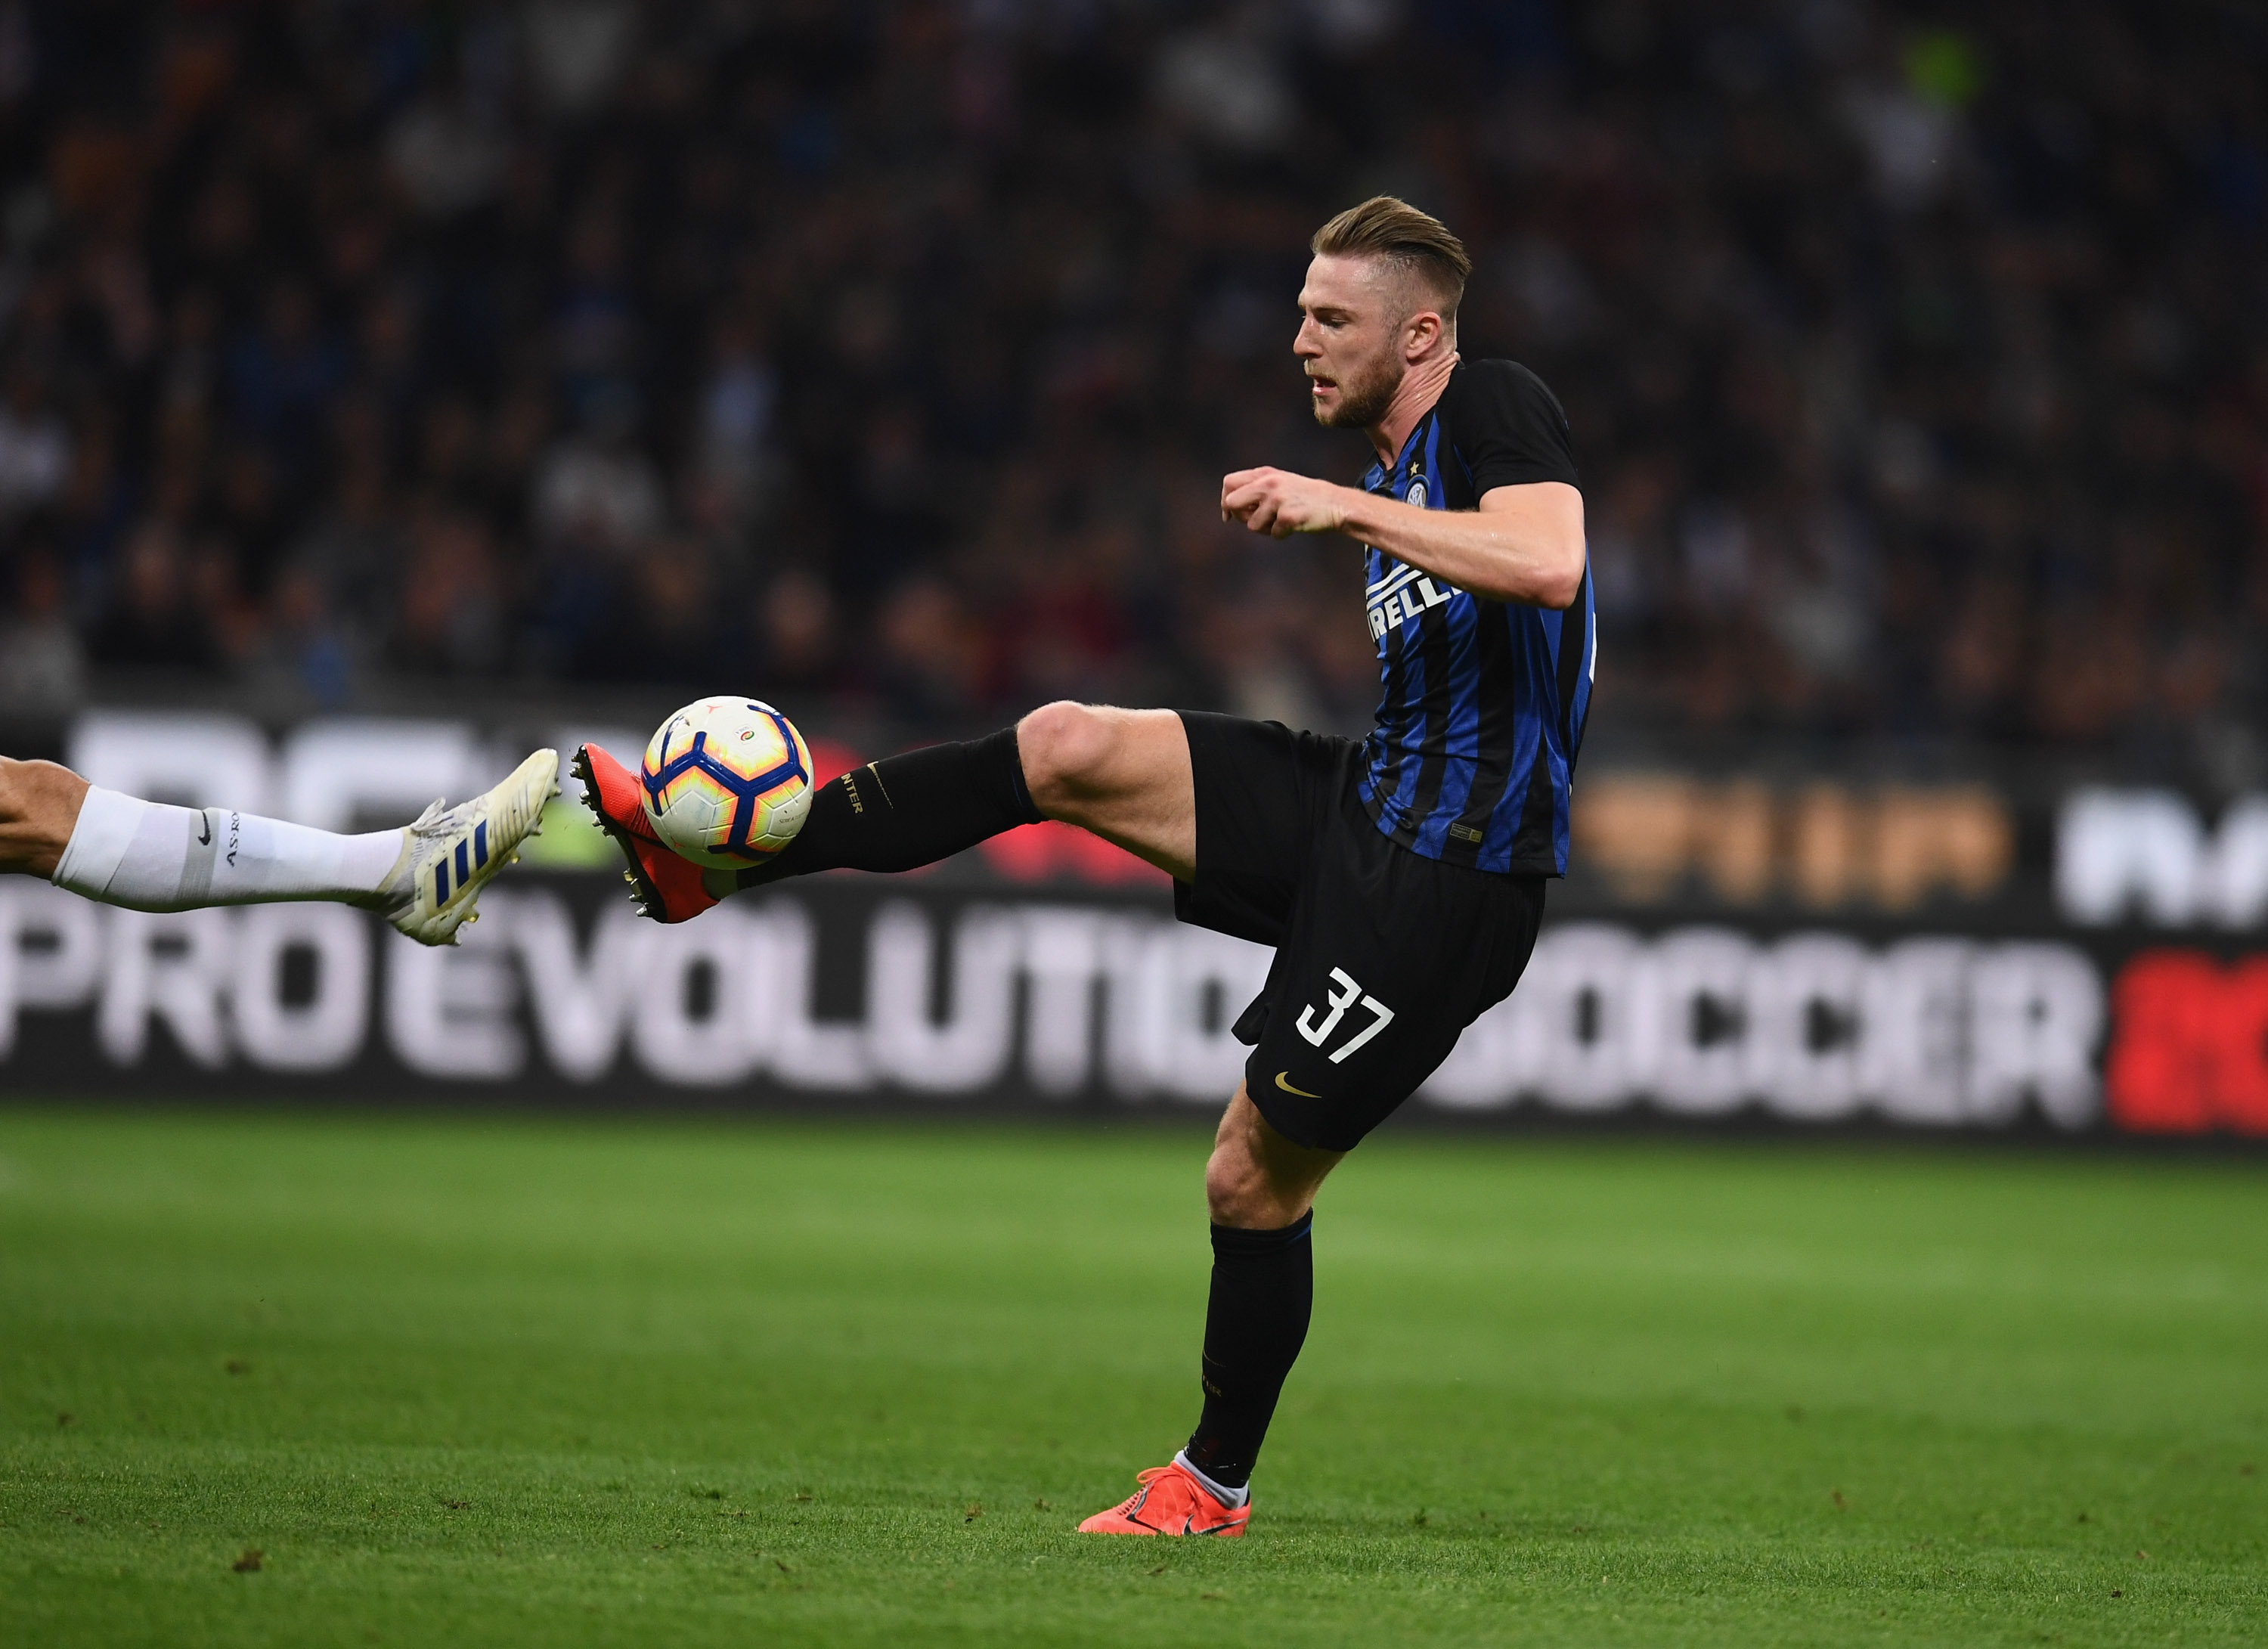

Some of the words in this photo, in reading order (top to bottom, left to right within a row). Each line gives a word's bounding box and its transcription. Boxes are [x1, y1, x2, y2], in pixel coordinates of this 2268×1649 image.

[1367, 577, 1464, 643] RELL
[0, 881, 369, 1070] PRO
[384, 892, 1278, 1100] EVOLUTIO
[1295, 966, 1395, 1064] 37
